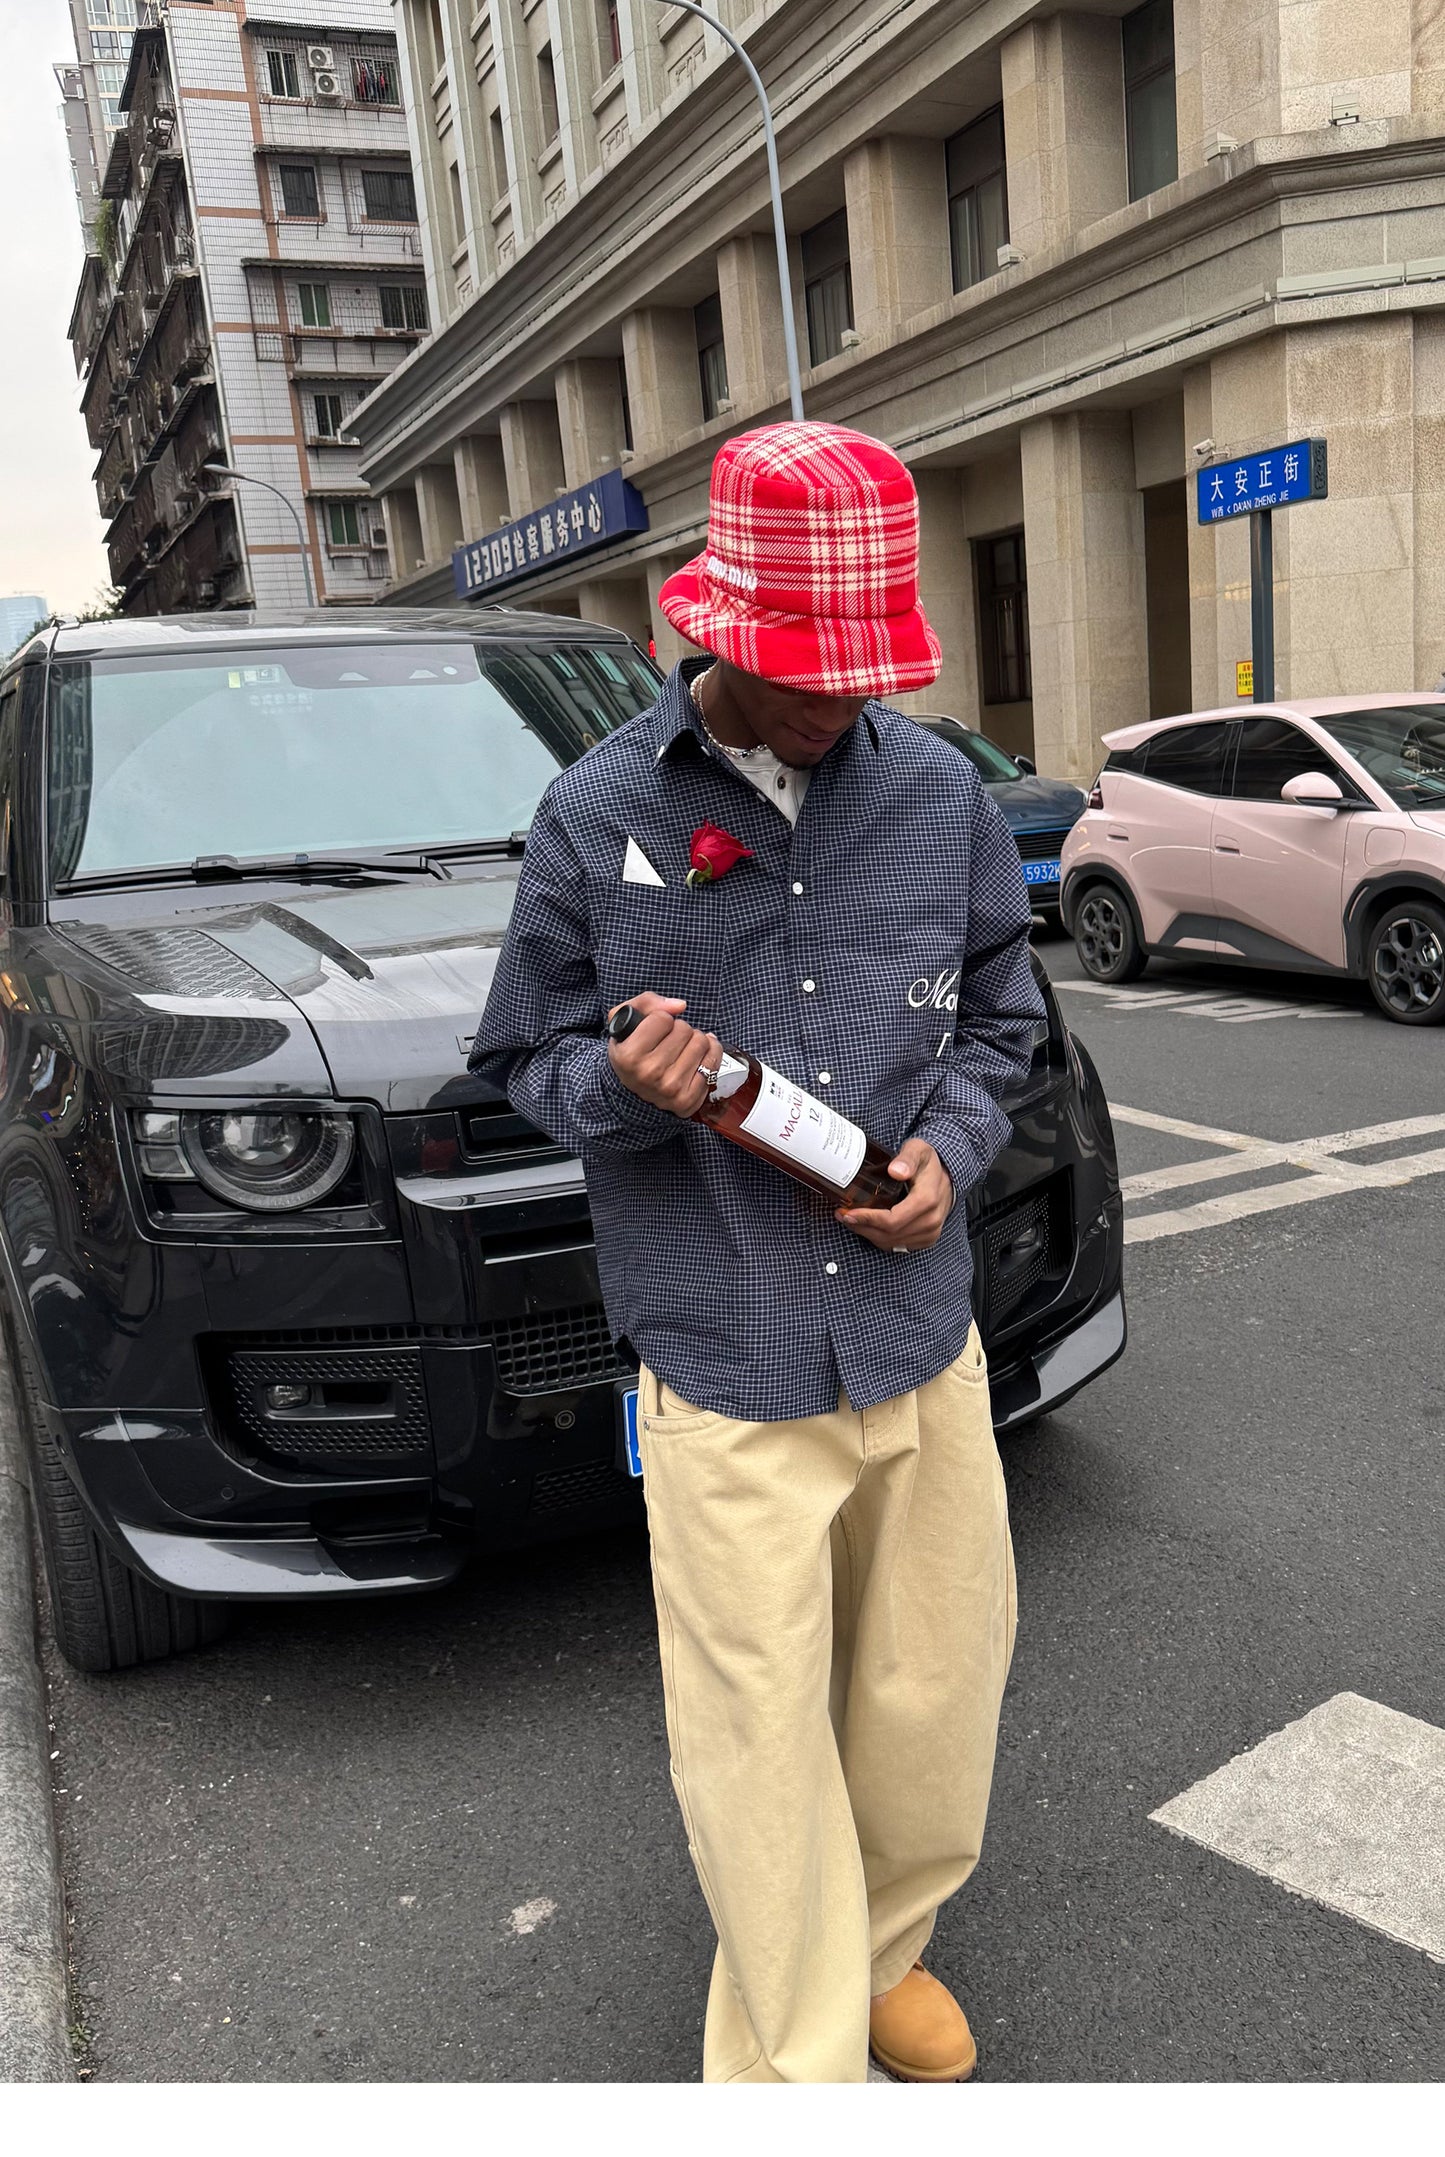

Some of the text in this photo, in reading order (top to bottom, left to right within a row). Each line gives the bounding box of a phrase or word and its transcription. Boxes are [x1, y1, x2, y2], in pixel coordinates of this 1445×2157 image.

[1210, 453, 1299, 502] 大安正街
[1254, 493, 1277, 508] ZHENG
[1279, 490, 1289, 502] JIE
[464, 493, 601, 588] 12309检察服务中心
[779, 1085, 803, 1141] MACALL
[809, 1107, 820, 1122] 12
